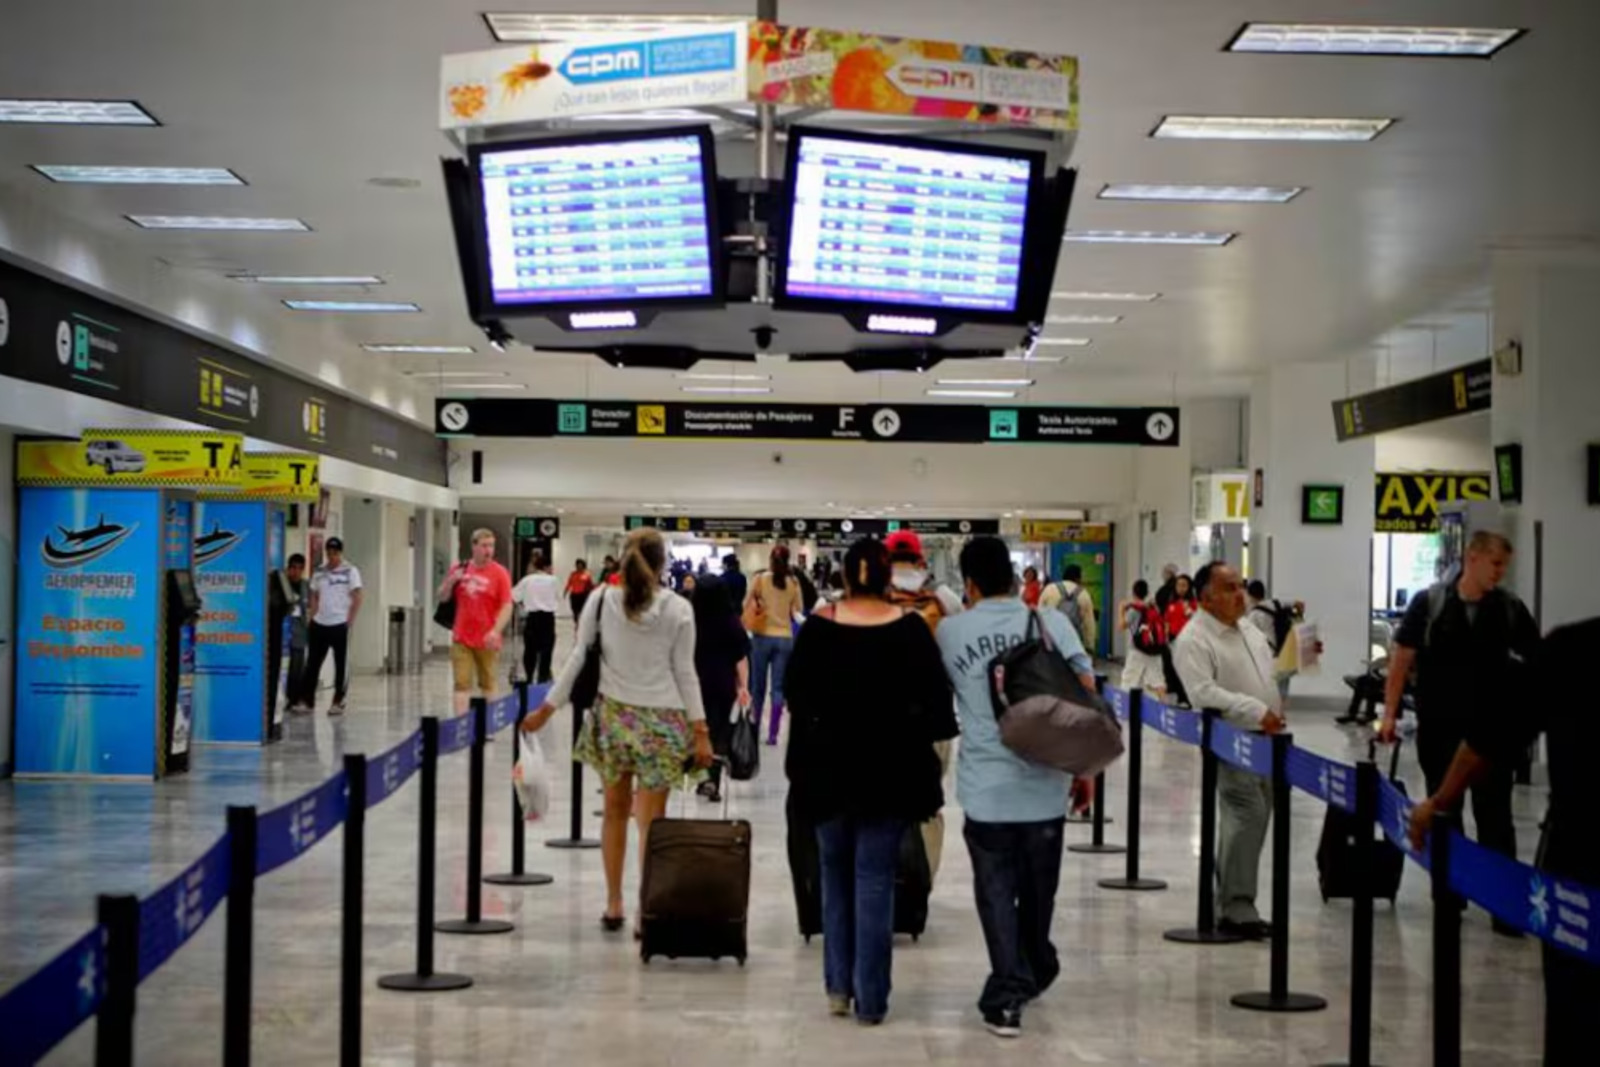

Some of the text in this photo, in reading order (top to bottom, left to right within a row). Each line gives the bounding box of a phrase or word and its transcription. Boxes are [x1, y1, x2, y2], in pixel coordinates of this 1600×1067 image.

[567, 50, 640, 77] cpm
[839, 407, 855, 429] F
[1375, 475, 1491, 516] AXIS
